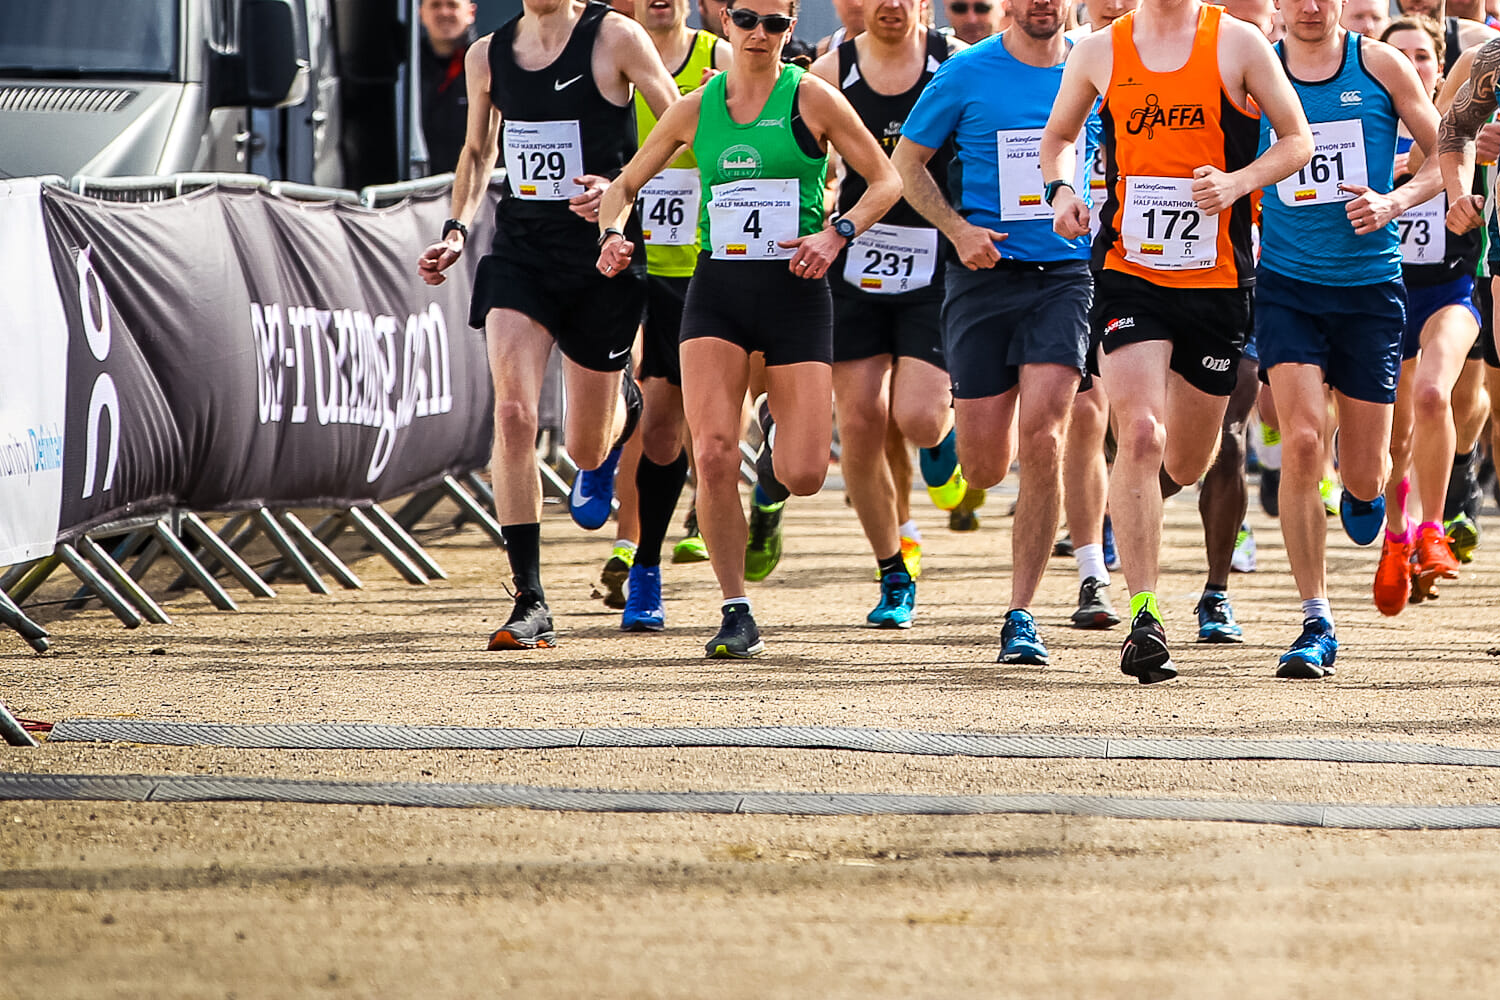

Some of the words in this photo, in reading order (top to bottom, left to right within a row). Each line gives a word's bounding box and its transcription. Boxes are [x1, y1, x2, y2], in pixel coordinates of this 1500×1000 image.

[1126, 105, 1205, 135] JAFFA
[1314, 143, 1339, 152] ATHON
[1340, 141, 1356, 149] 2018
[517, 151, 566, 180] 129
[714, 200, 731, 208] HALF
[733, 200, 774, 208] MARATHON
[1152, 200, 1193, 208] MARATHON
[743, 209, 762, 239] 4
[1142, 208, 1200, 240] 172
[862, 250, 915, 277] 231
